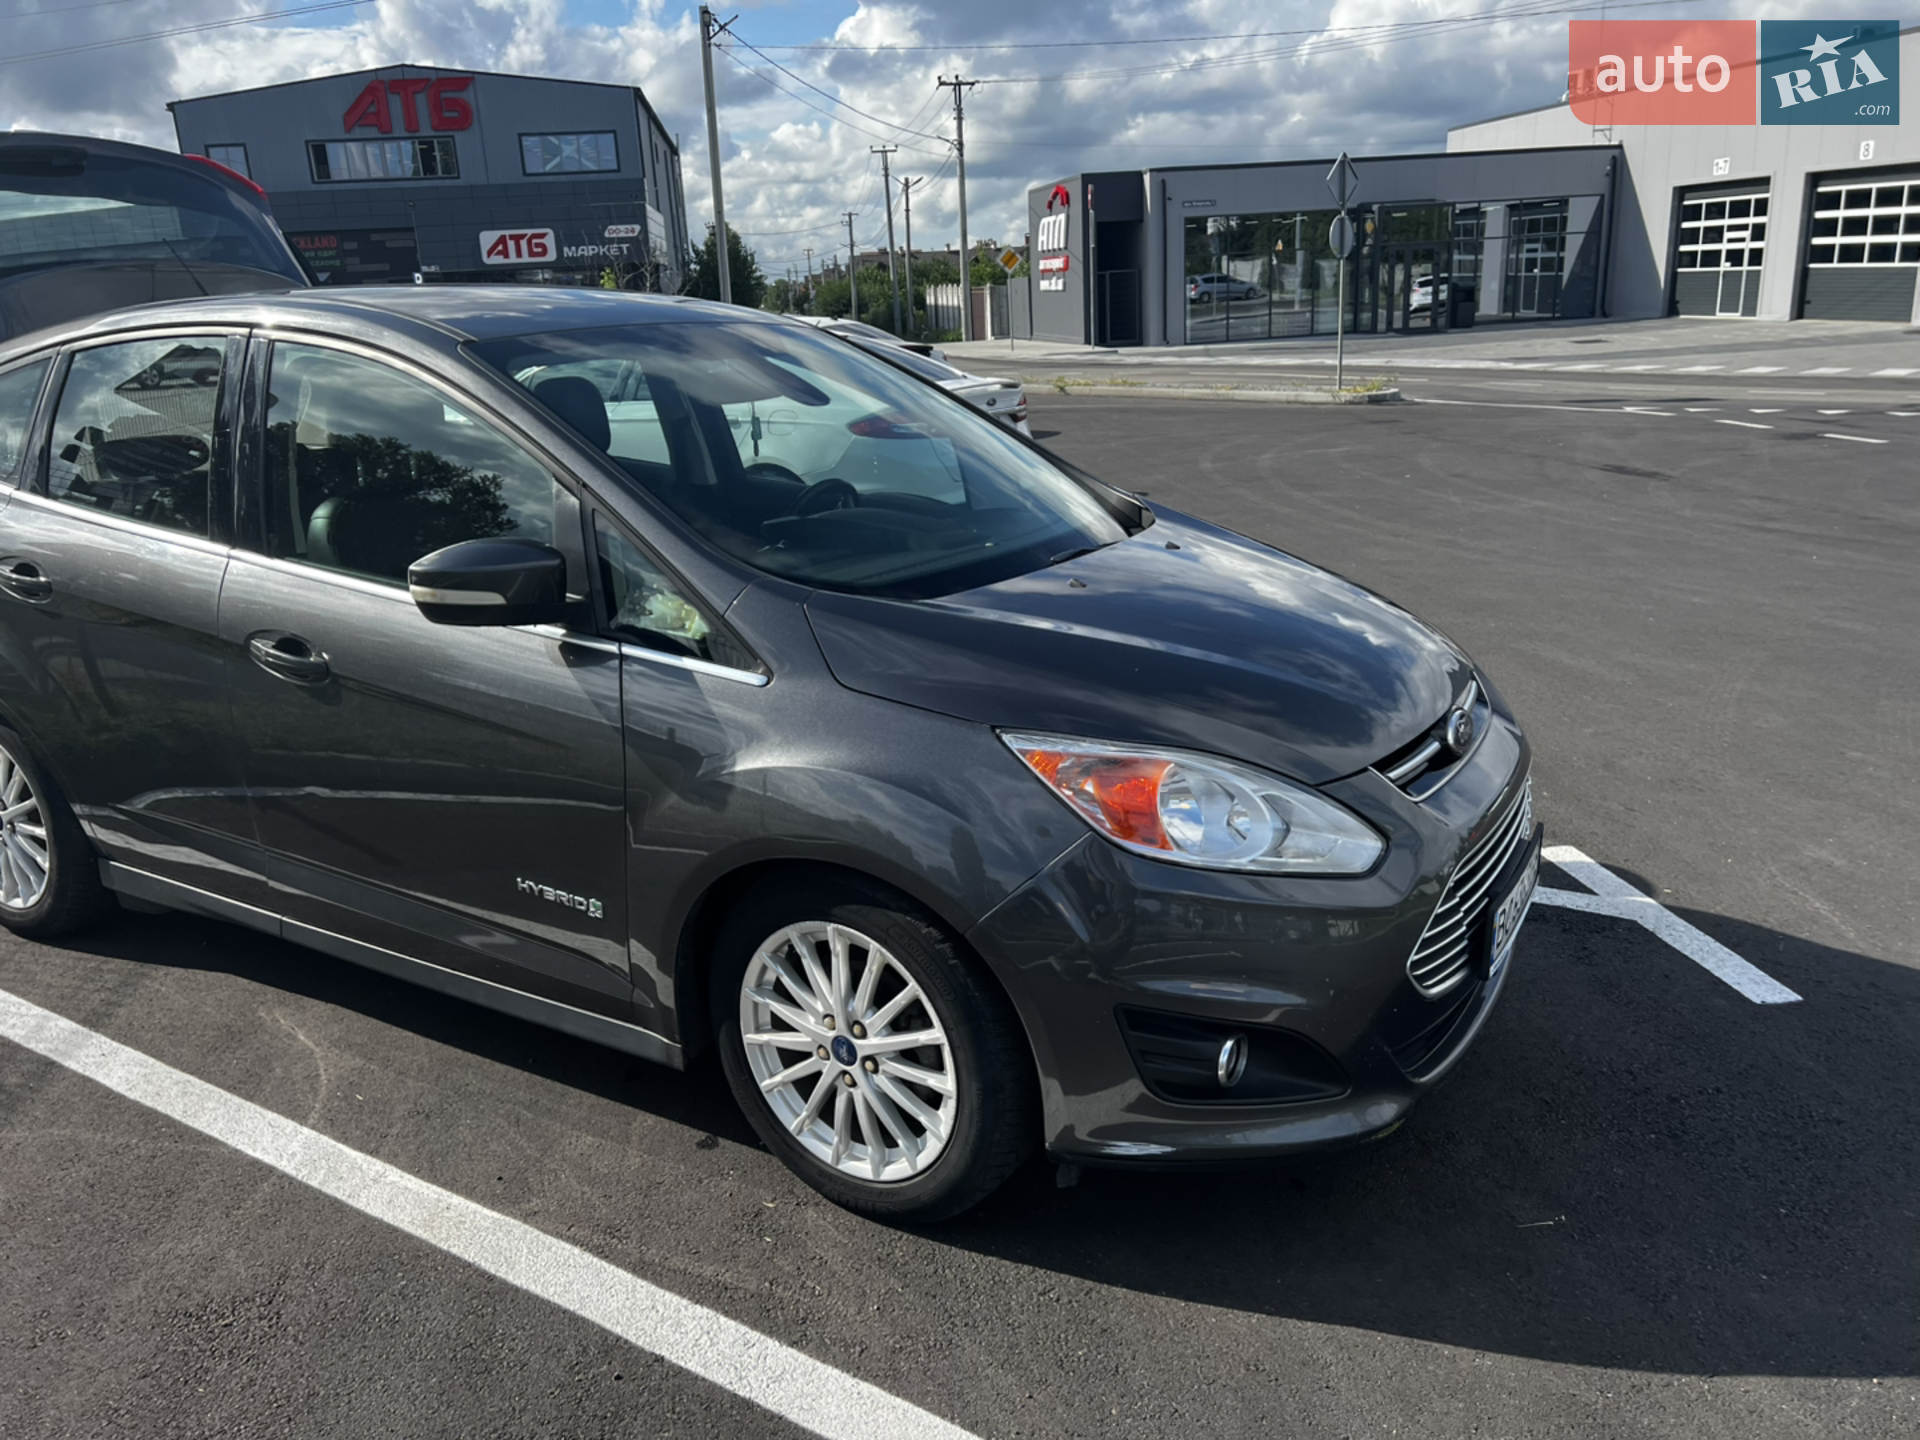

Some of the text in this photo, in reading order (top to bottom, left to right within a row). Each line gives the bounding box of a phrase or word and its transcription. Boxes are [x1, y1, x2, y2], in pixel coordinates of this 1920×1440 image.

[343, 76, 475, 134] АТБ
[1862, 143, 1870, 158] 8
[486, 232, 549, 260] АТБ
[563, 243, 630, 258] МАРКЕТ
[516, 877, 588, 911] HYBRID
